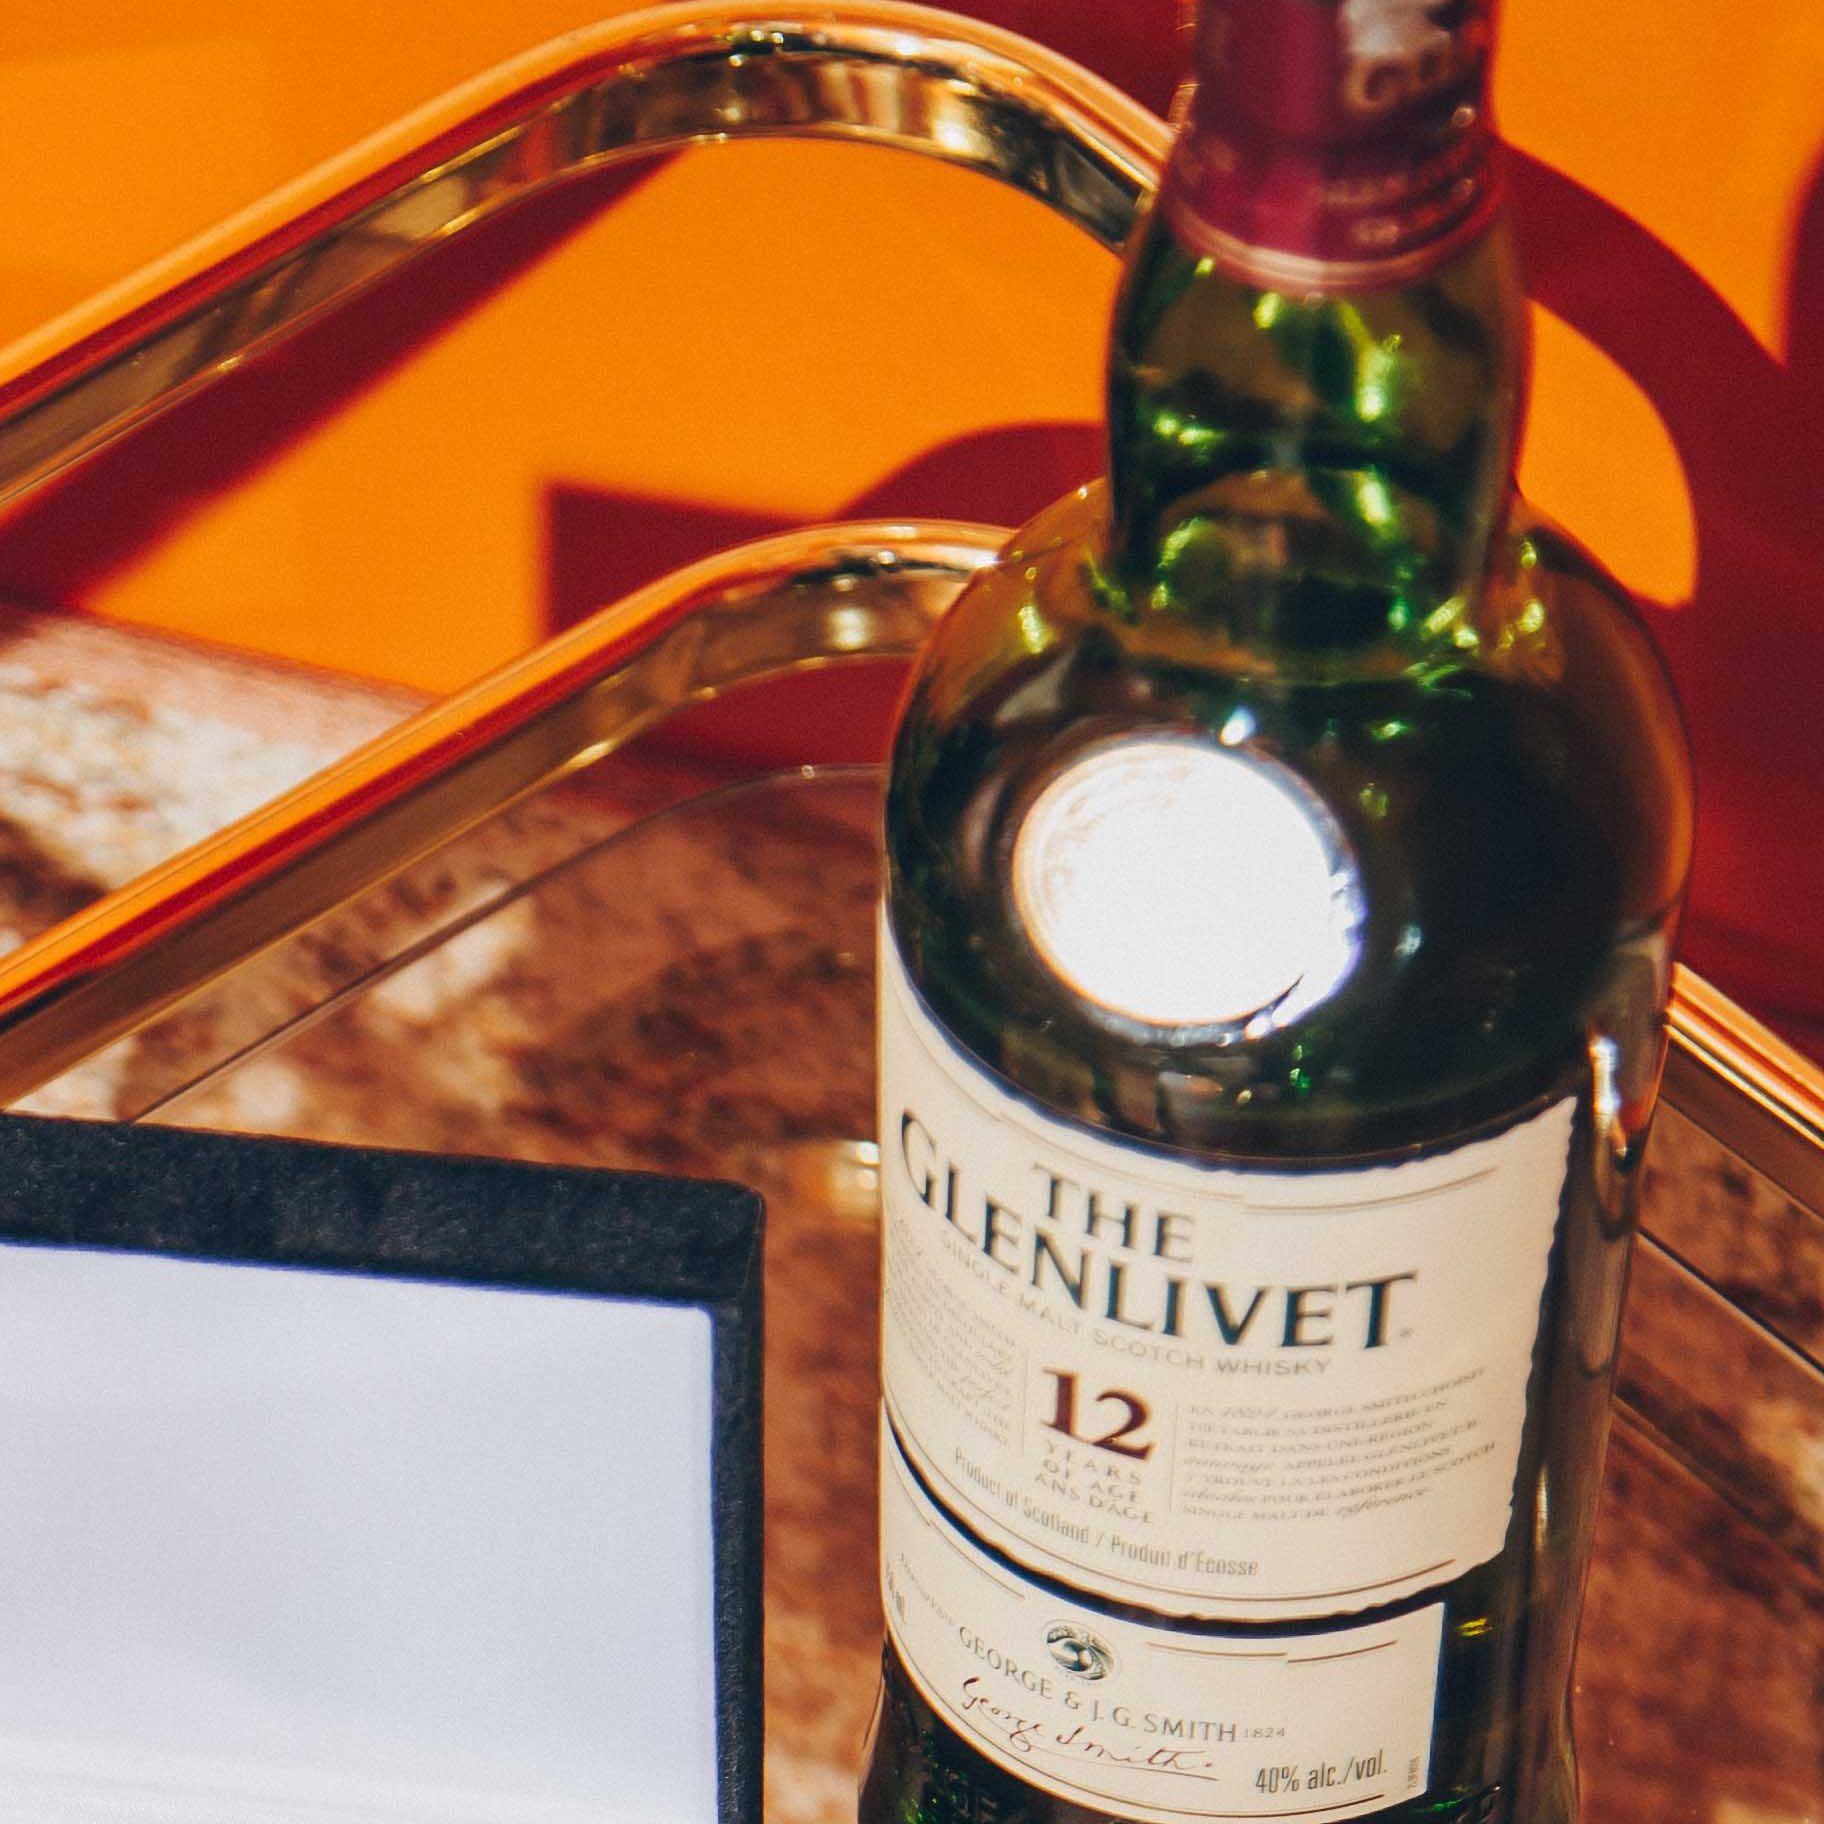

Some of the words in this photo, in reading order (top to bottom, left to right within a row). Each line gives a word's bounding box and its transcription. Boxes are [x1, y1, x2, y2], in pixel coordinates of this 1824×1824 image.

[899, 1110, 1418, 1350] GLENLIVET
[1033, 1162, 1196, 1263] THE
[1093, 1327, 1204, 1370] SCOTCH
[1216, 1357, 1334, 1376] WHISKY
[1040, 1367, 1155, 1461] 12
[955, 1447, 1001, 1499] Product
[1023, 1497, 1090, 1544] Scotland
[1111, 1534, 1170, 1568] Produit
[1047, 1439, 1142, 1487] YEARS
[959, 1625, 1054, 1700] GEORGE
[1064, 1690, 1081, 1710] &
[1143, 1712, 1237, 1743] SMITH
[1242, 1726, 1288, 1739] 1824
[1255, 1764, 1300, 1795] 40%
[1307, 1748, 1388, 1791] alc./vol.
